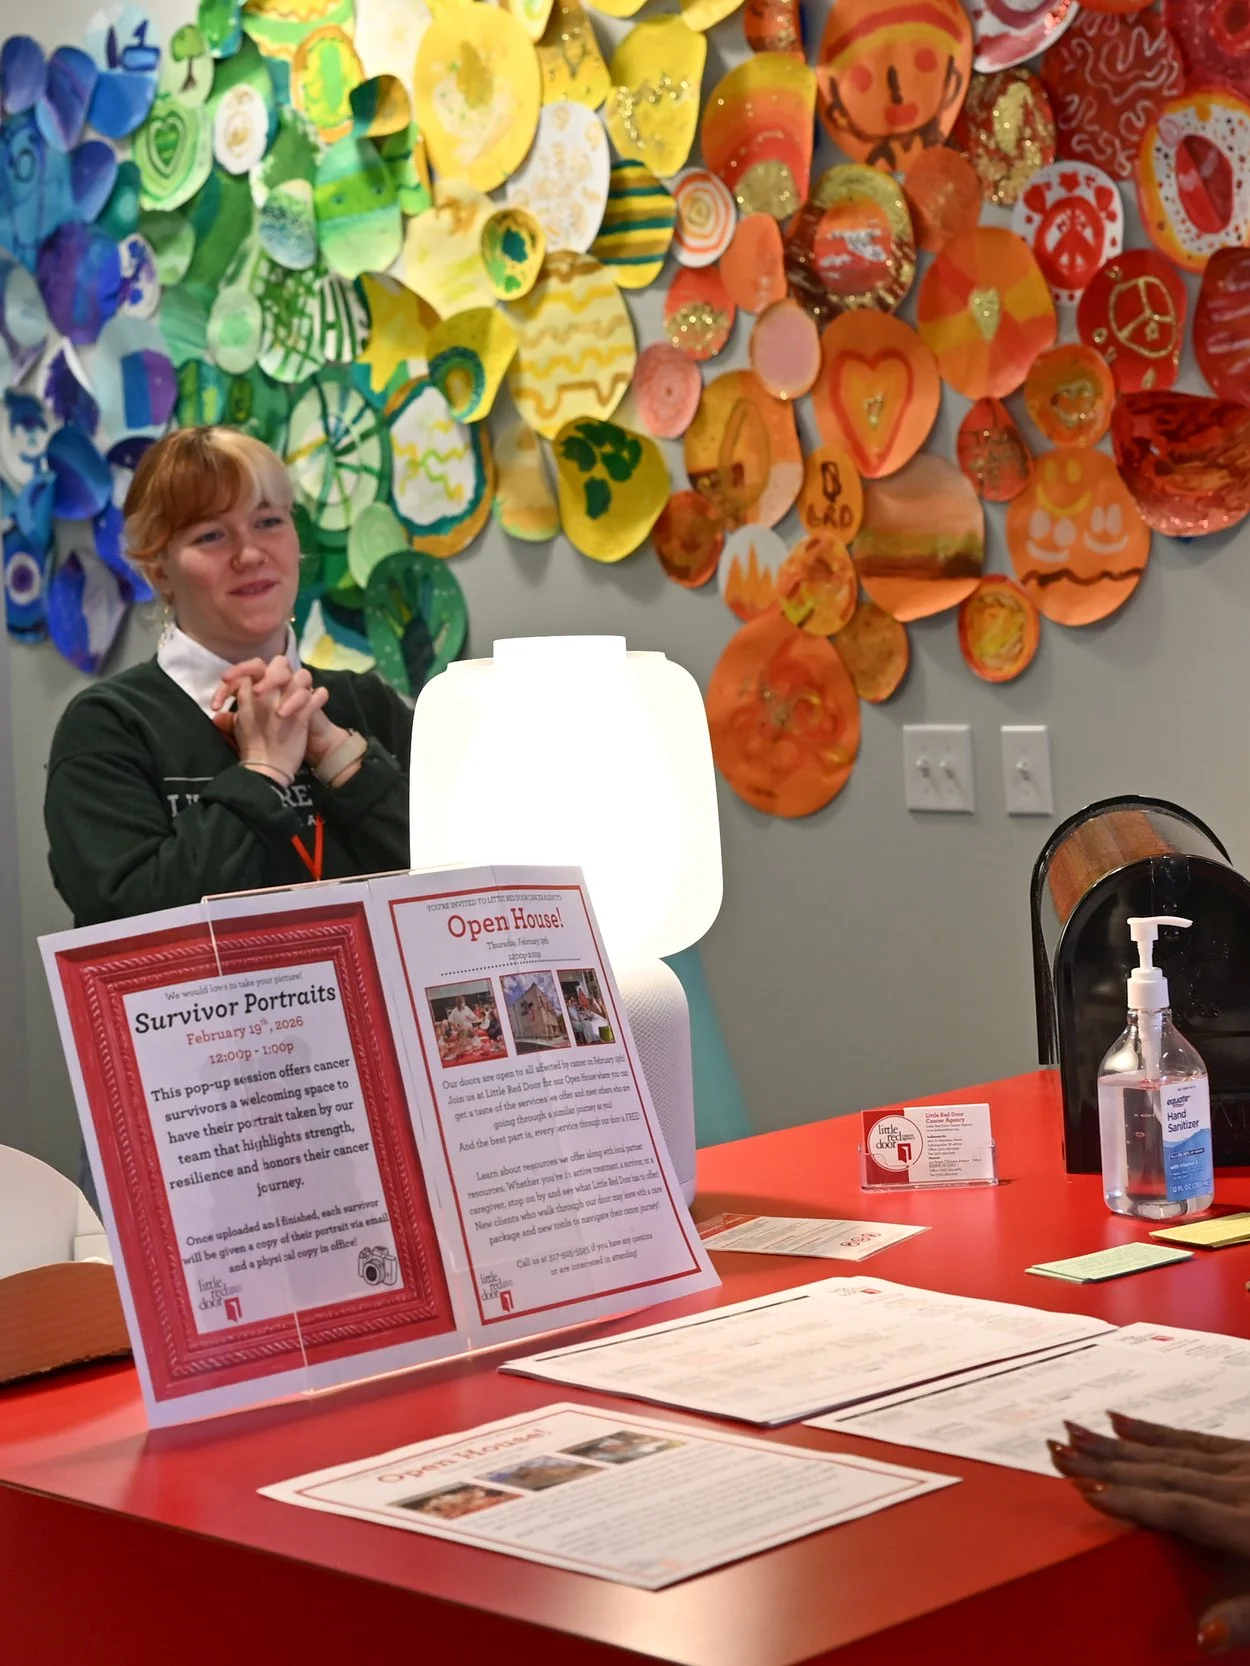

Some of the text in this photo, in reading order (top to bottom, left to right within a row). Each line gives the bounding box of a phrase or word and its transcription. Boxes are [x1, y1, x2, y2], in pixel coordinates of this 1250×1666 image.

[448, 907, 563, 941] Open House!
[165, 992, 179, 1000] We
[182, 985, 208, 997] would
[238, 979, 254, 987] take
[256, 978, 272, 987] your
[274, 972, 301, 984] picture!
[135, 985, 335, 1033] Survivor Portraits
[186, 1027, 245, 1045] February
[275, 1016, 303, 1030] 2026
[209, 1049, 251, 1064] 12:00p
[262, 1042, 294, 1054] 1:00p
[150, 1059, 349, 1101] This pop-up session offers cancer
[442, 1080, 457, 1089] Our
[460, 1077, 480, 1086] doors
[496, 1072, 514, 1081] open
[525, 1065, 534, 1074] all
[561, 1060, 568, 1070] by
[165, 1102, 227, 1121] survivors
[240, 1088, 301, 1106] welcoming
[304, 1083, 334, 1097] space
[337, 1080, 348, 1089] to
[448, 1096, 464, 1104] Join
[485, 1086, 505, 1098] Little
[507, 1083, 521, 1093] Red
[522, 1082, 541, 1090] Door
[565, 1075, 580, 1084] Open
[1167, 1096, 1190, 1106] equate
[167, 1131, 199, 1143] have
[203, 1122, 233, 1136] their
[285, 1107, 316, 1120] taken
[318, 1103, 332, 1116] by
[335, 1102, 353, 1111] our
[493, 1119, 515, 1130] going
[516, 1110, 546, 1123] through
[576, 1104, 595, 1115] journey
[878, 1124, 898, 1135] little
[1168, 1109, 1186, 1121] Hand
[1168, 1120, 1199, 1132] Sanitizer
[178, 1151, 211, 1164] team
[214, 1144, 240, 1156] that
[305, 1120, 354, 1139] strength,
[459, 1140, 475, 1151] And
[476, 1138, 488, 1148] the
[489, 1136, 506, 1145] best
[508, 1133, 523, 1144] part
[535, 1128, 554, 1136] every
[876, 1139, 896, 1149] door
[888, 1131, 902, 1141] red
[169, 1143, 369, 1189] resilience and honors their cancer
[257, 1178, 304, 1196] journey.
[186, 1235, 213, 1246] Once
[216, 1221, 260, 1240] uploaded
[281, 1209, 320, 1225] finished,
[321, 1205, 341, 1217] each
[343, 1200, 378, 1212] survivor
[183, 1252, 202, 1264] will
[203, 1250, 216, 1260] be
[219, 1246, 246, 1259] given
[256, 1239, 277, 1249] copy
[280, 1232, 289, 1243] of
[291, 1230, 312, 1241] their
[314, 1223, 348, 1239] portrait
[350, 1220, 363, 1228] via
[365, 1213, 388, 1225] email
[229, 1260, 247, 1272] and
[297, 1248, 317, 1258] copy
[331, 1237, 356, 1250] office!
[378, 1458, 456, 1483] Open
